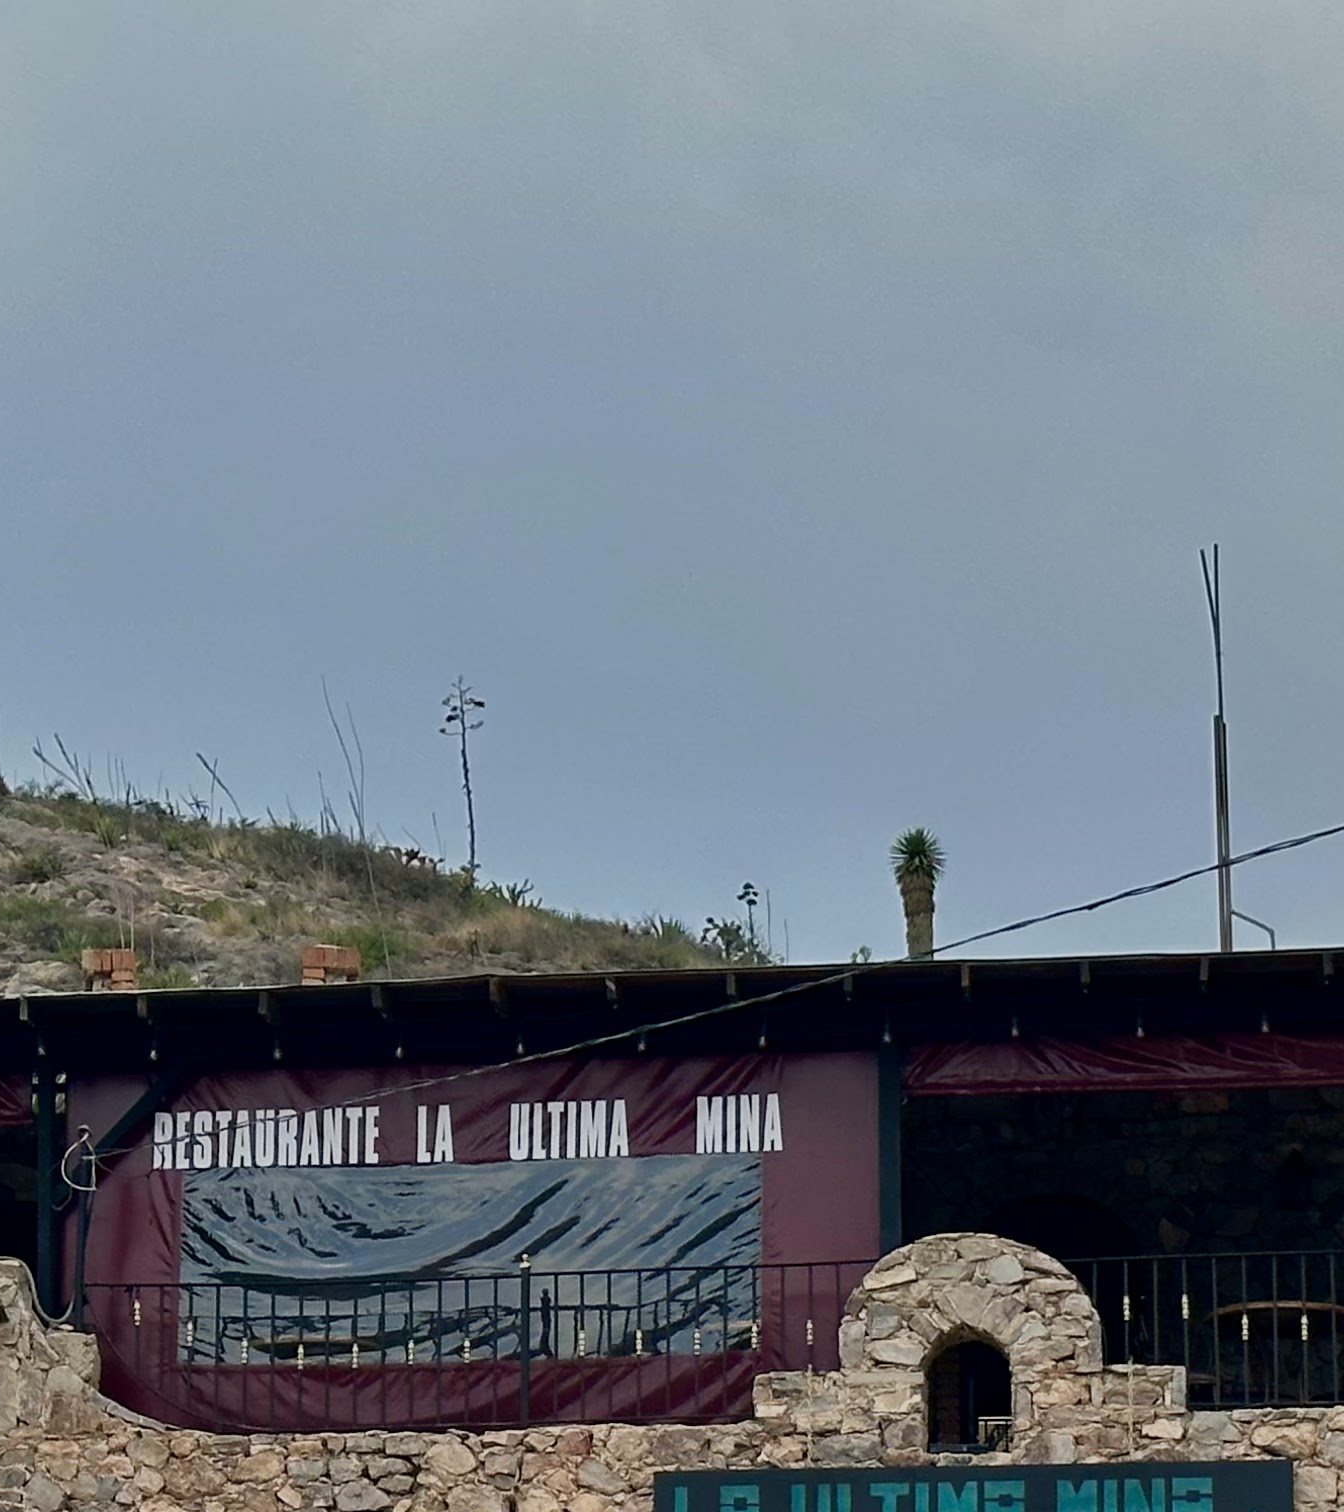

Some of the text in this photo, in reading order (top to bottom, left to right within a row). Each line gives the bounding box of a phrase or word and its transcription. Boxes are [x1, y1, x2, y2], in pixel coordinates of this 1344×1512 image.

[153, 1093, 783, 1170] RESTAURANTE LA ULTIMA MINA
